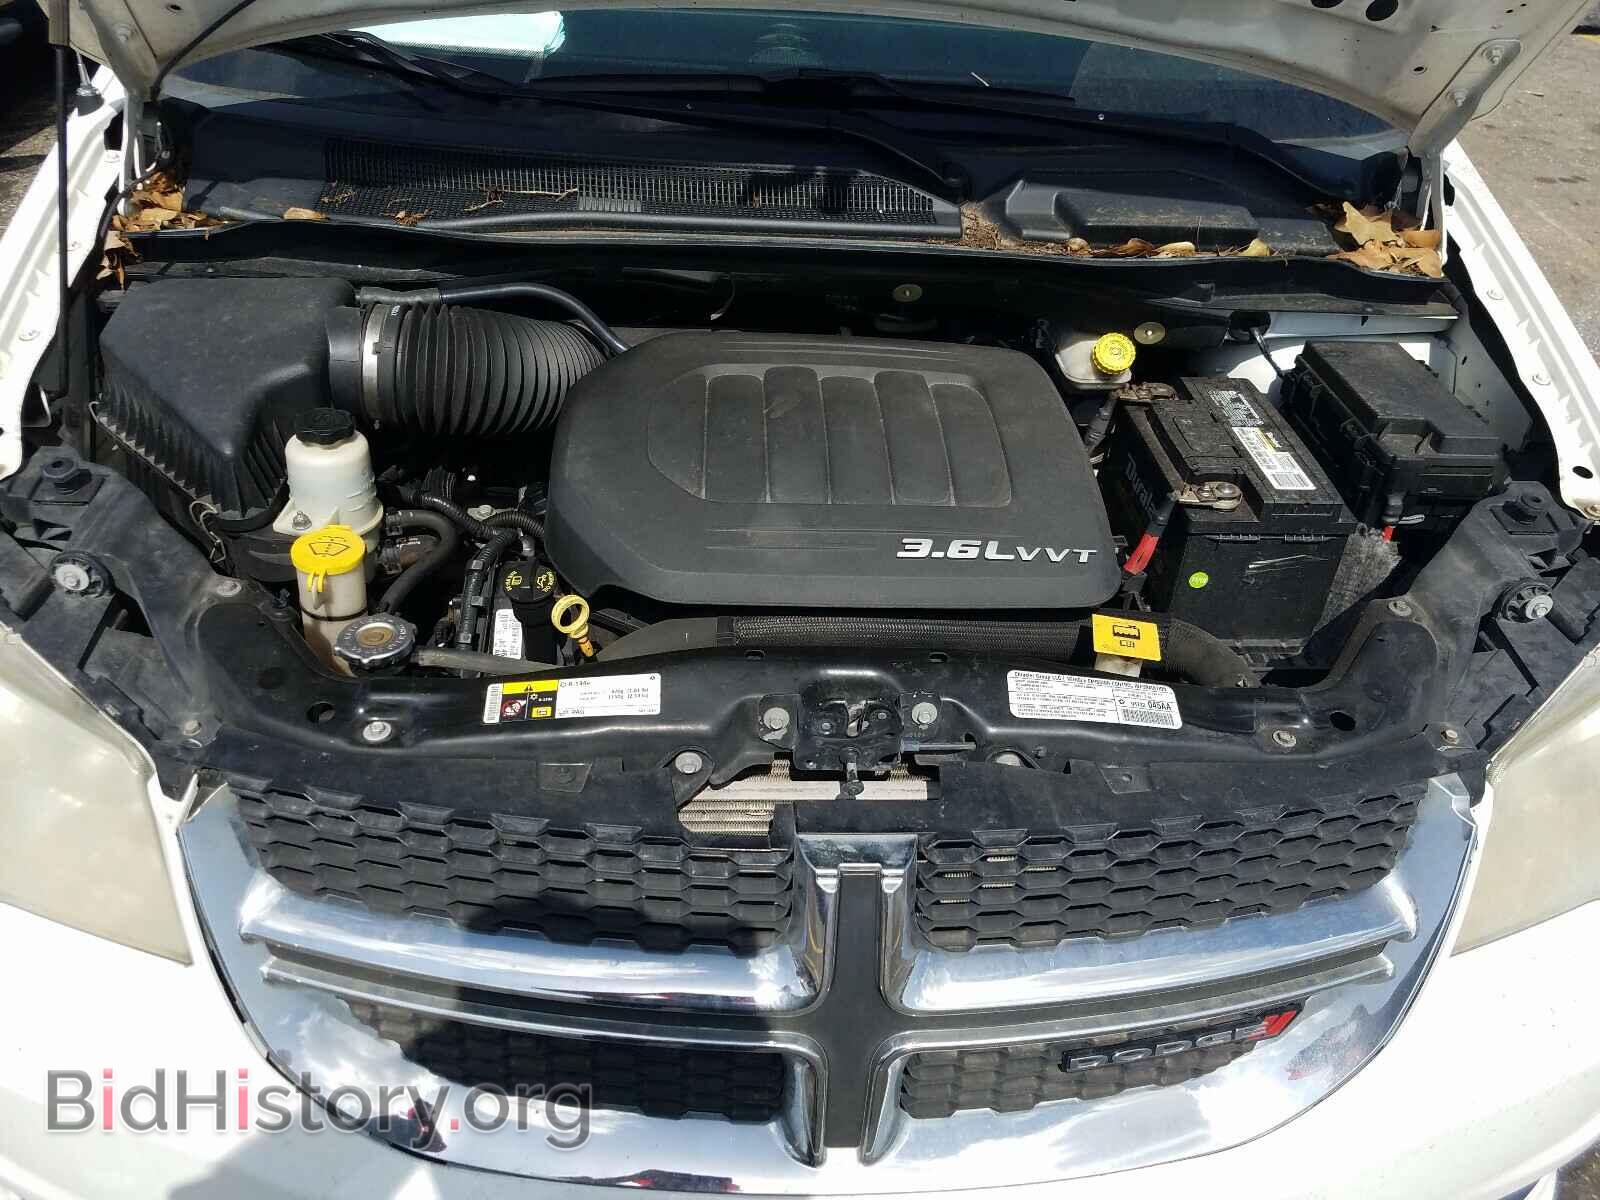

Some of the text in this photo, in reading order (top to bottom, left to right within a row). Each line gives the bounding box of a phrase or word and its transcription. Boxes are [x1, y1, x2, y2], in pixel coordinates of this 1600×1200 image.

[897, 538, 1098, 563] 3.6L VVT
[1068, 1024, 1262, 1073] DODGE
